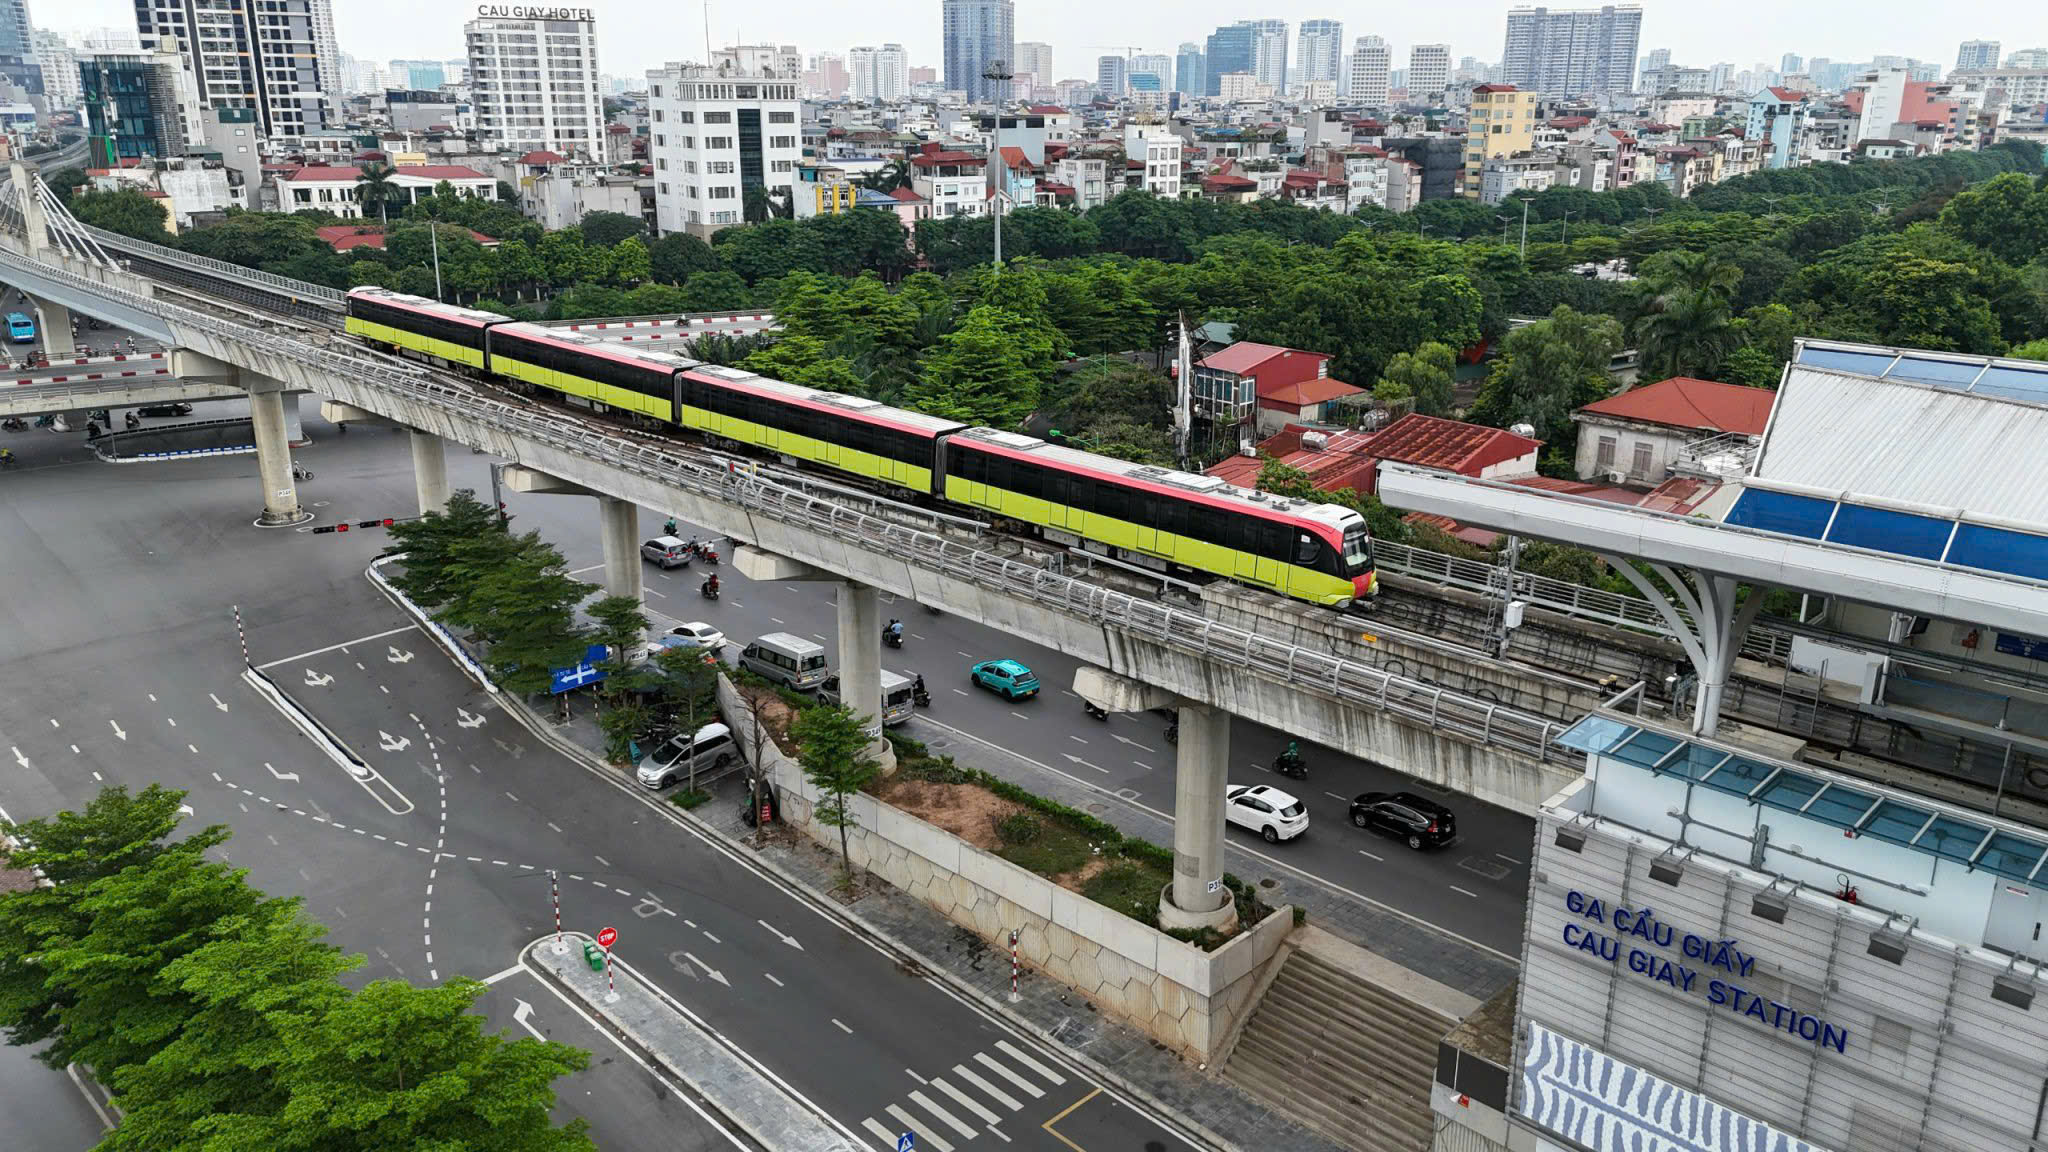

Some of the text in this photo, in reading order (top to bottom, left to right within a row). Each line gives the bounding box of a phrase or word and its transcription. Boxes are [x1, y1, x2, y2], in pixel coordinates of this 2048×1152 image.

[478, 5, 595, 20] CAU GIAY HOTEL
[600, 932, 615, 942] STOP
[1566, 889, 1755, 977] GA CẦU GIẤY
[1563, 923, 1848, 1054] CAU GIAY STATION
